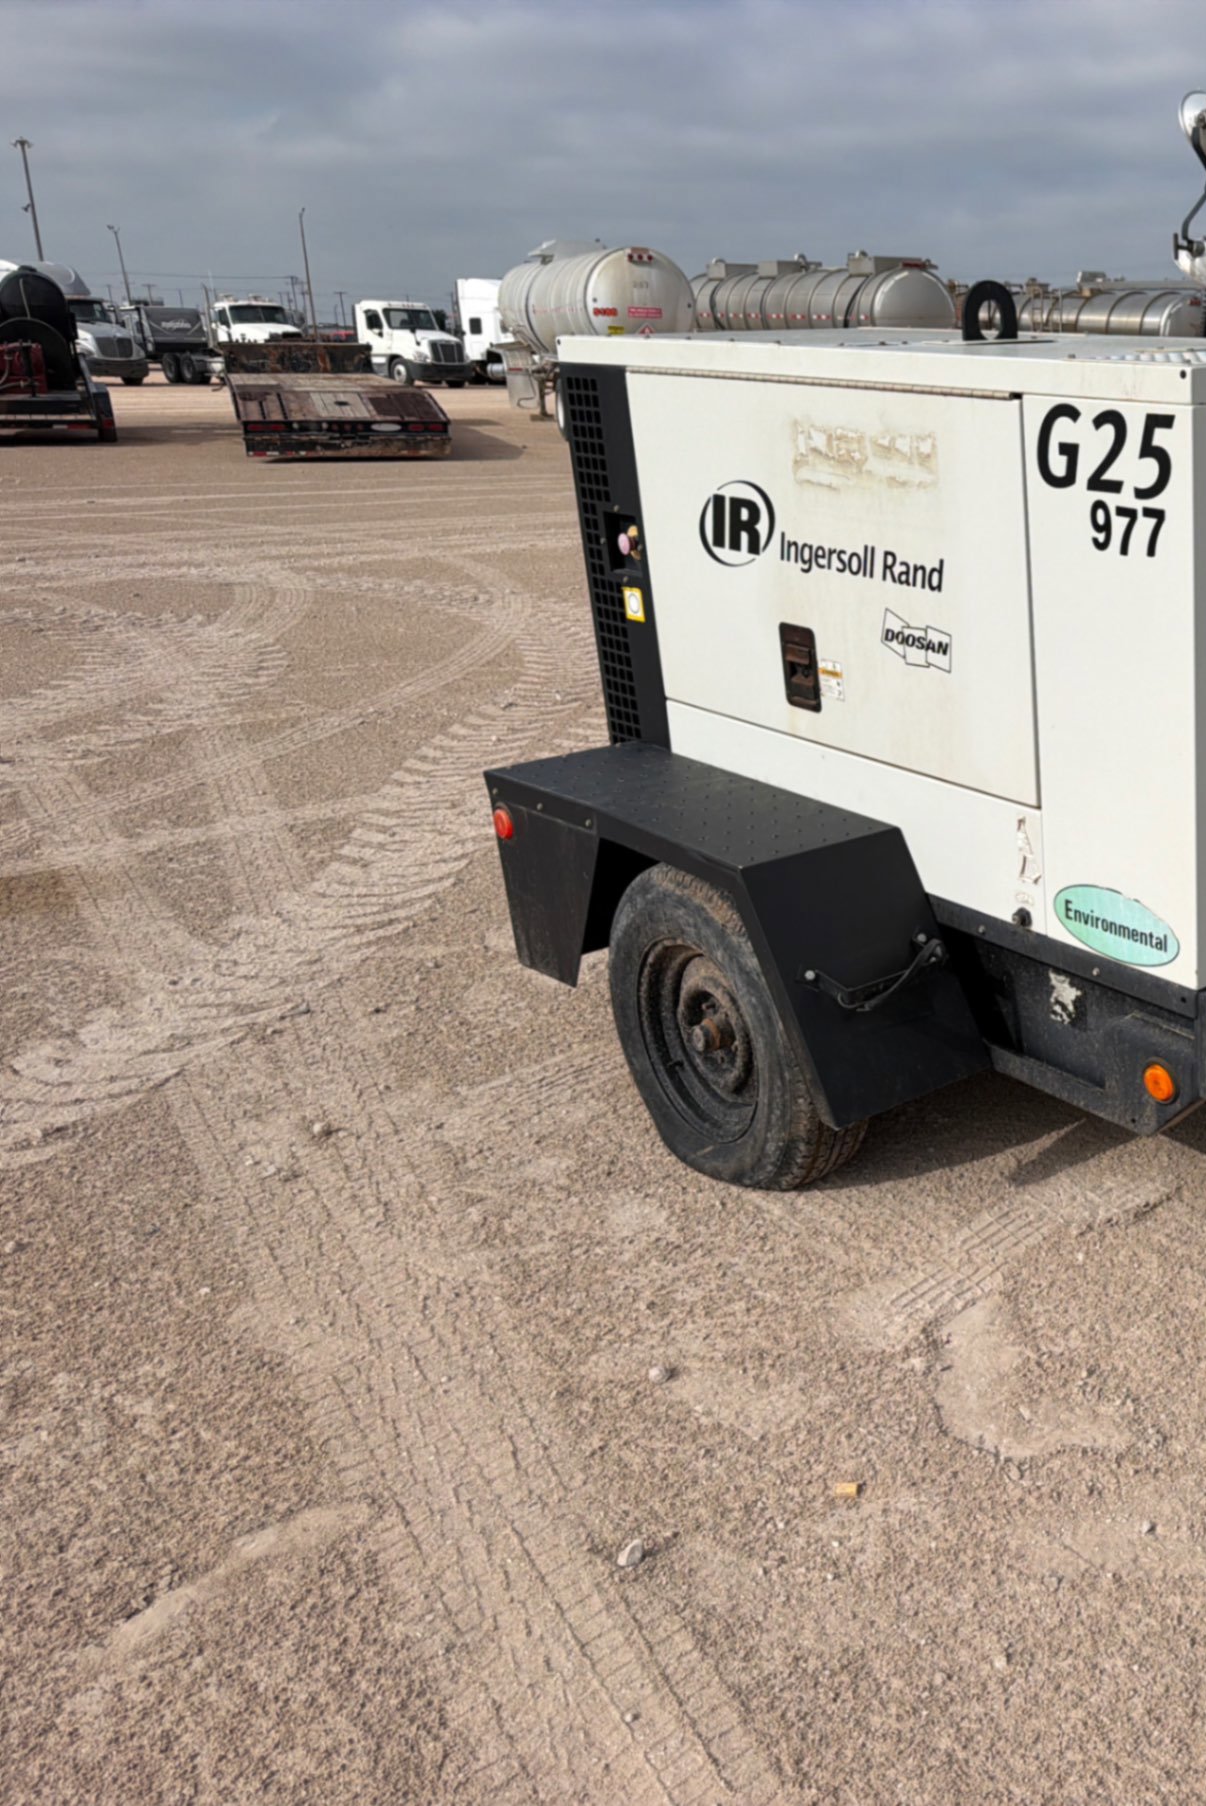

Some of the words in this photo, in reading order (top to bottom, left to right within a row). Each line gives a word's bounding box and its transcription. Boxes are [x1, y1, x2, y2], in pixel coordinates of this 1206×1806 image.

[1037, 403, 1176, 501] G25
[711, 493, 761, 556] IR
[1090, 499, 1166, 558] 977
[780, 531, 875, 579] Ingersoll
[882, 550, 944, 593] Rand
[884, 628, 949, 656] DOOSAN
[1064, 899, 1168, 952] Environmental
